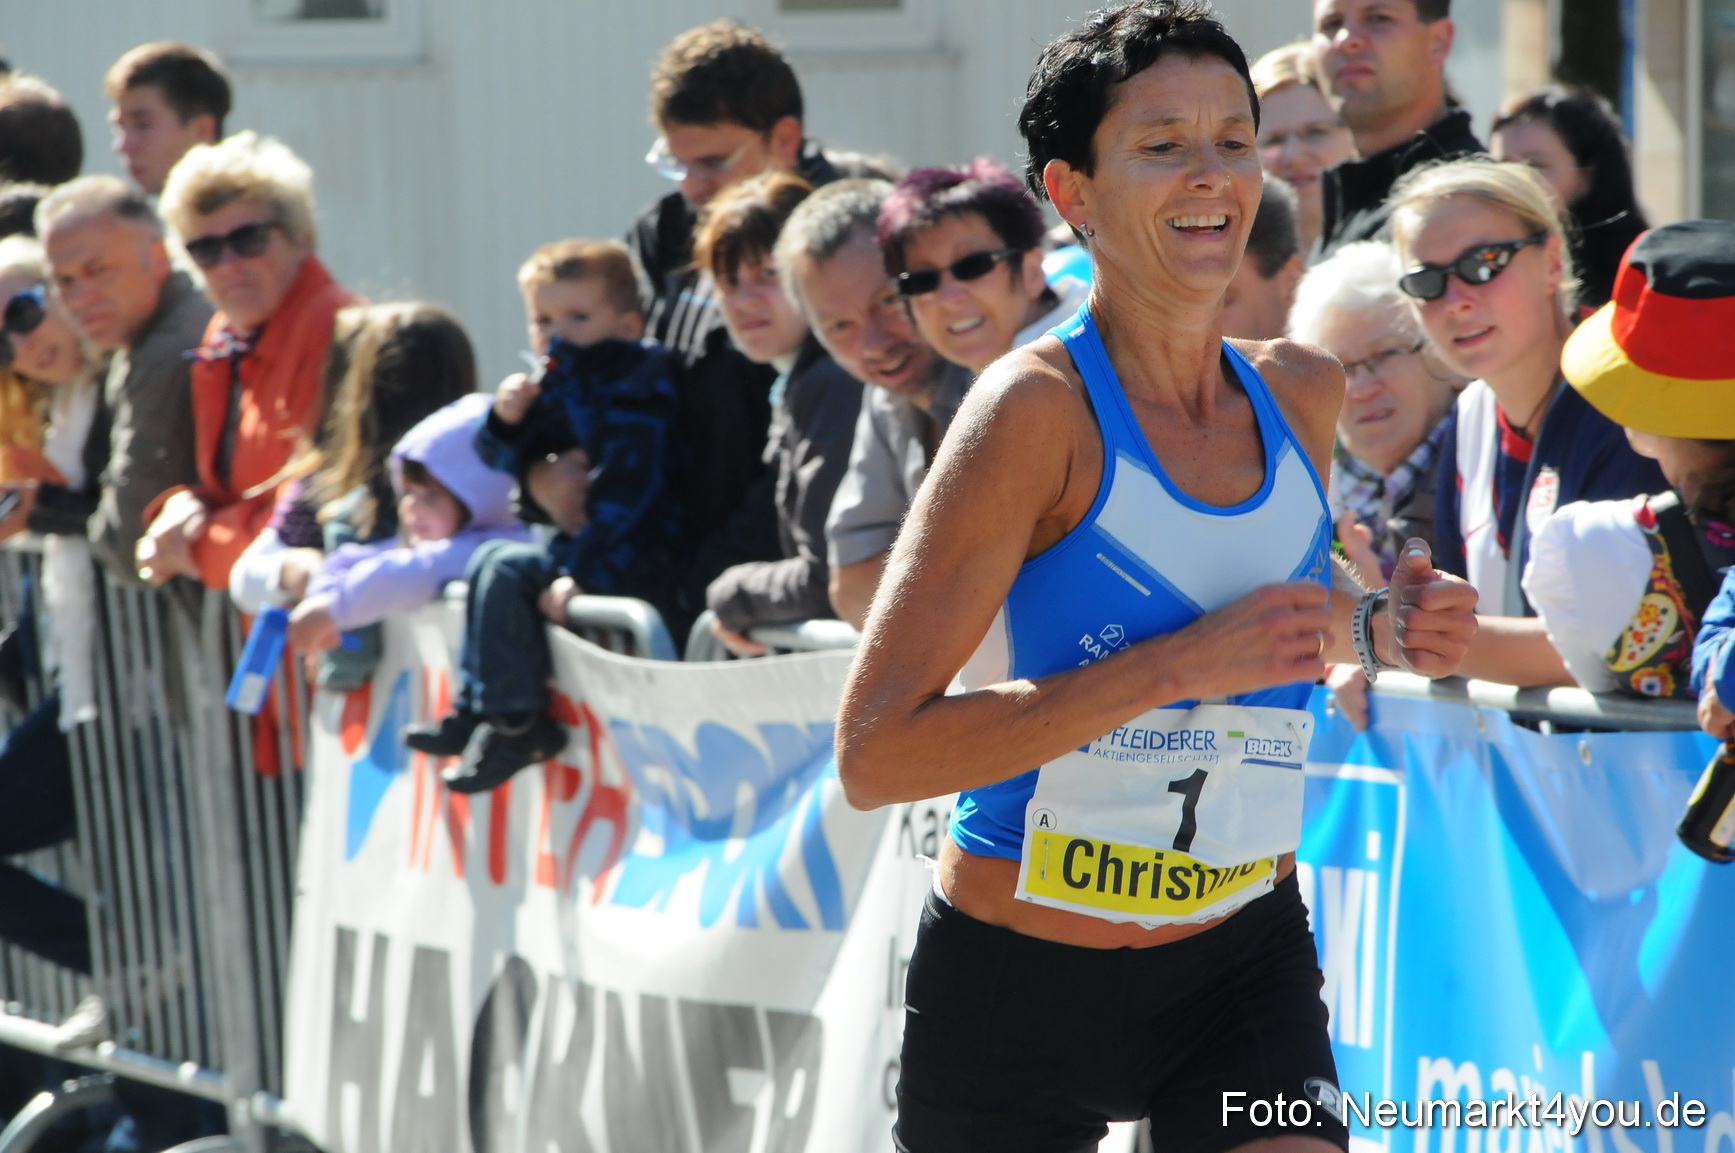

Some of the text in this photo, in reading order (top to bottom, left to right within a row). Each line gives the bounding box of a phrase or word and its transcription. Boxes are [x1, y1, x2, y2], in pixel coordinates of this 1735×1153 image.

[1097, 726, 1218, 751] FLEIDERER
[1244, 738, 1292, 758] BOCK
[1039, 813, 1049, 828] A
[1167, 767, 1209, 853] 1
